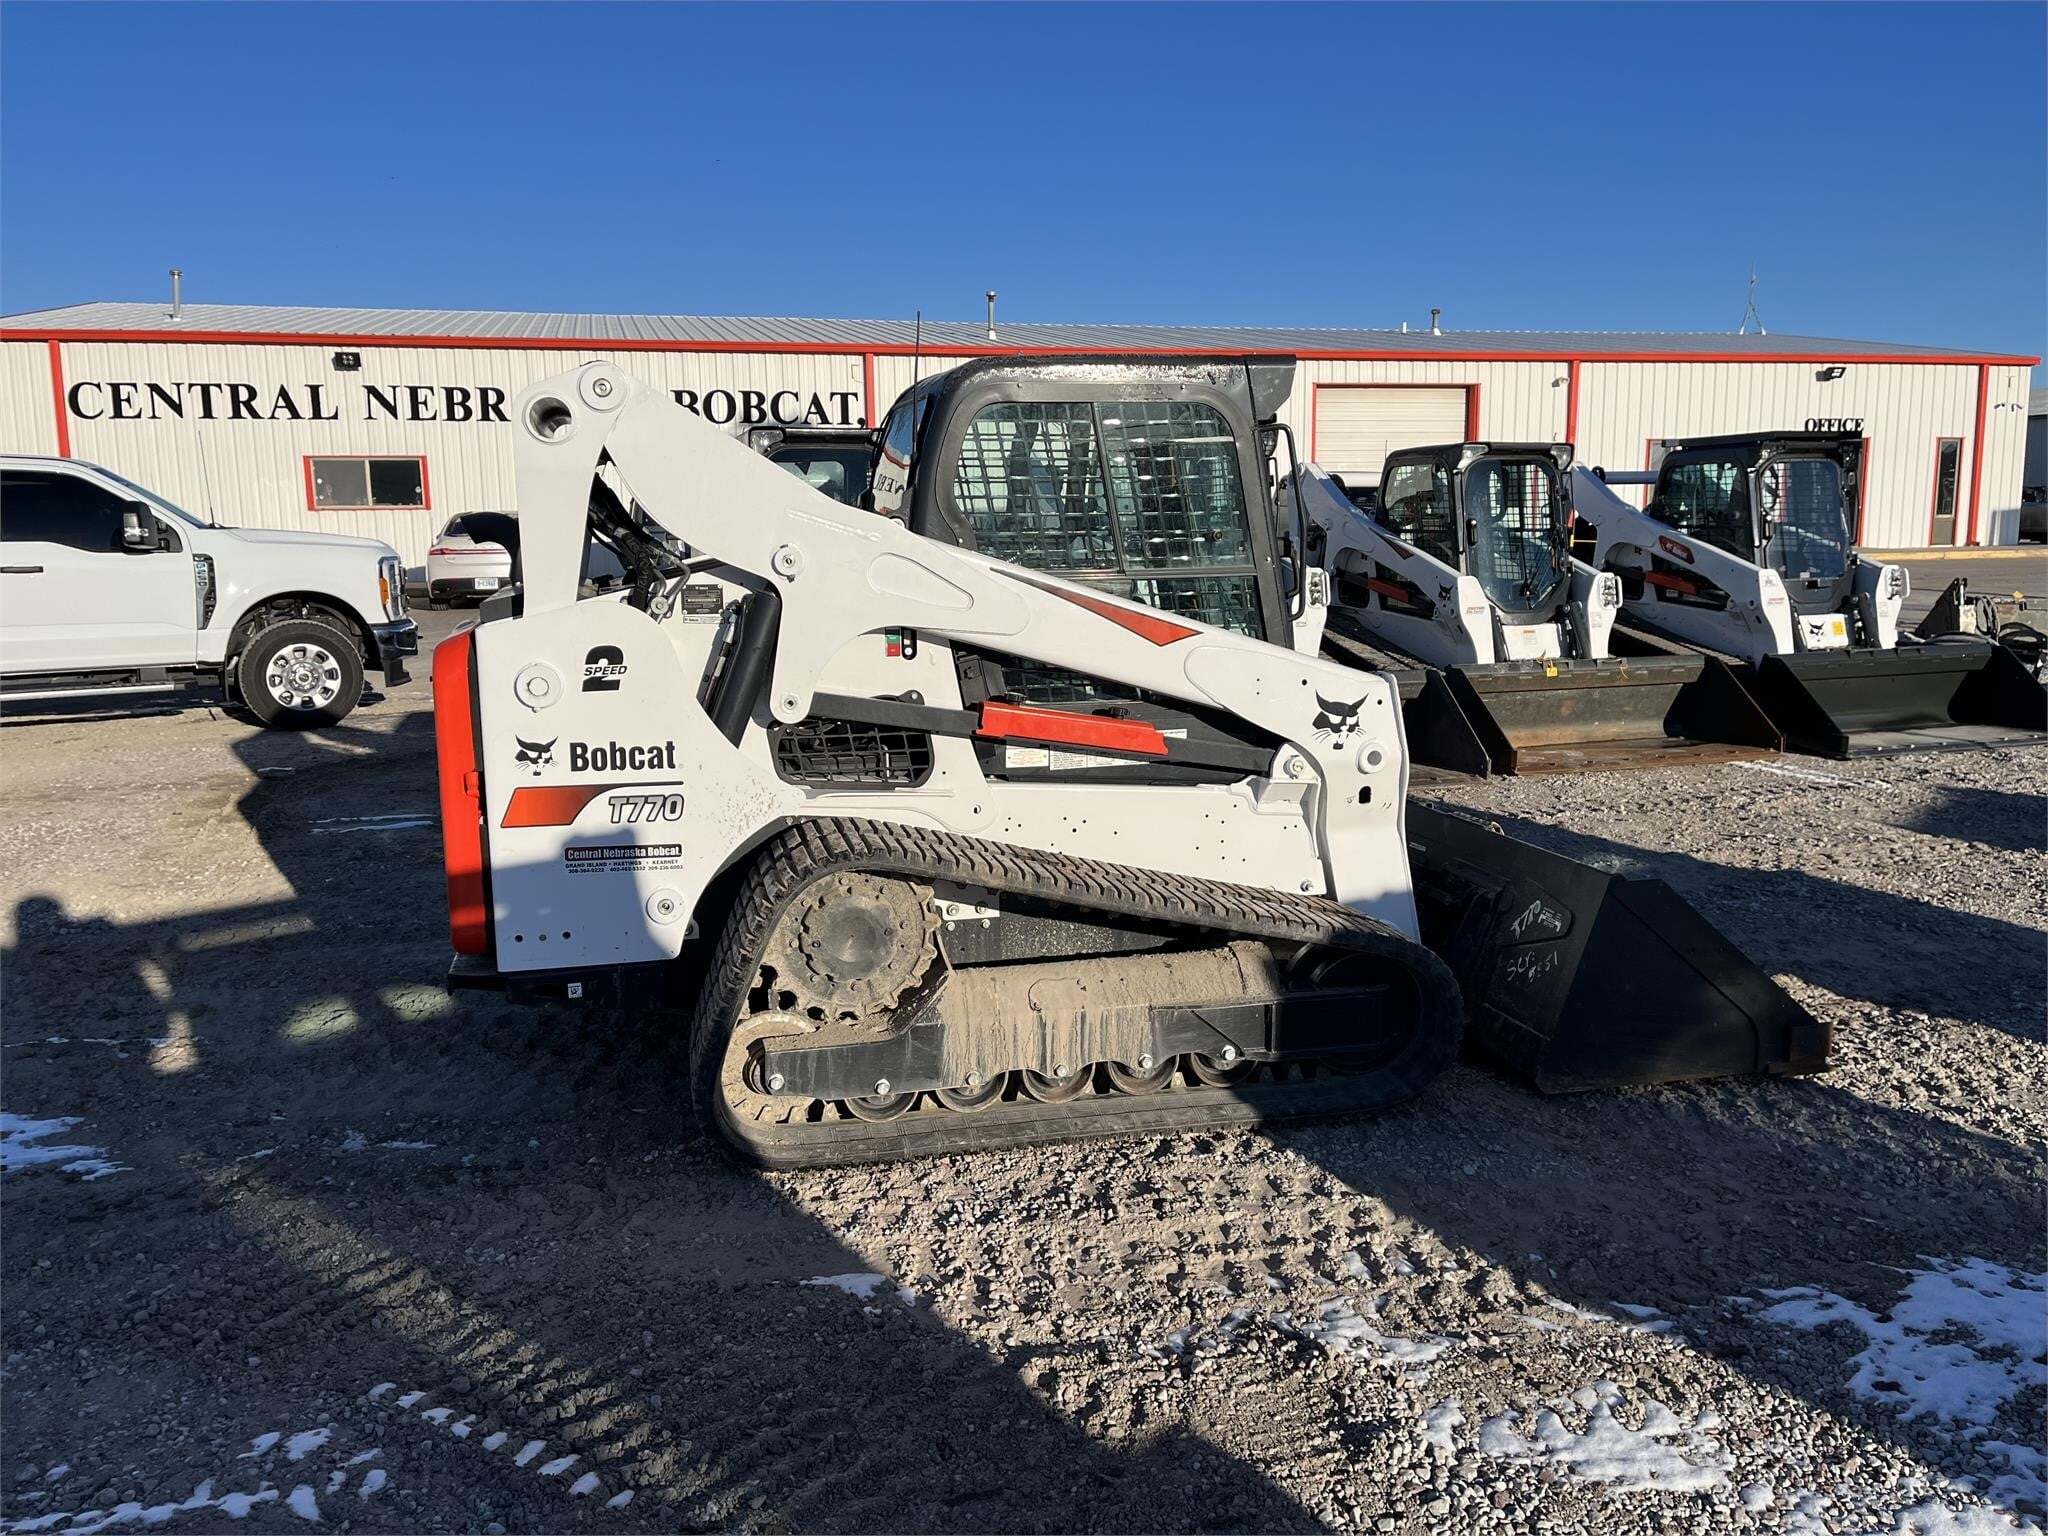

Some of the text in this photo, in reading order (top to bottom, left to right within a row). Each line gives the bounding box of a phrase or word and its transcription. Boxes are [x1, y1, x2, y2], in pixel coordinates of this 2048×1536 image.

[68, 381, 339, 421] CENTRAL
[1804, 417, 1864, 431] OFFICE
[582, 645, 628, 692] 2 SPEED
[569, 741, 676, 772] Bobcat
[608, 793, 684, 824] T770
[567, 848, 602, 860] Central
[603, 847, 646, 859] Nebraska
